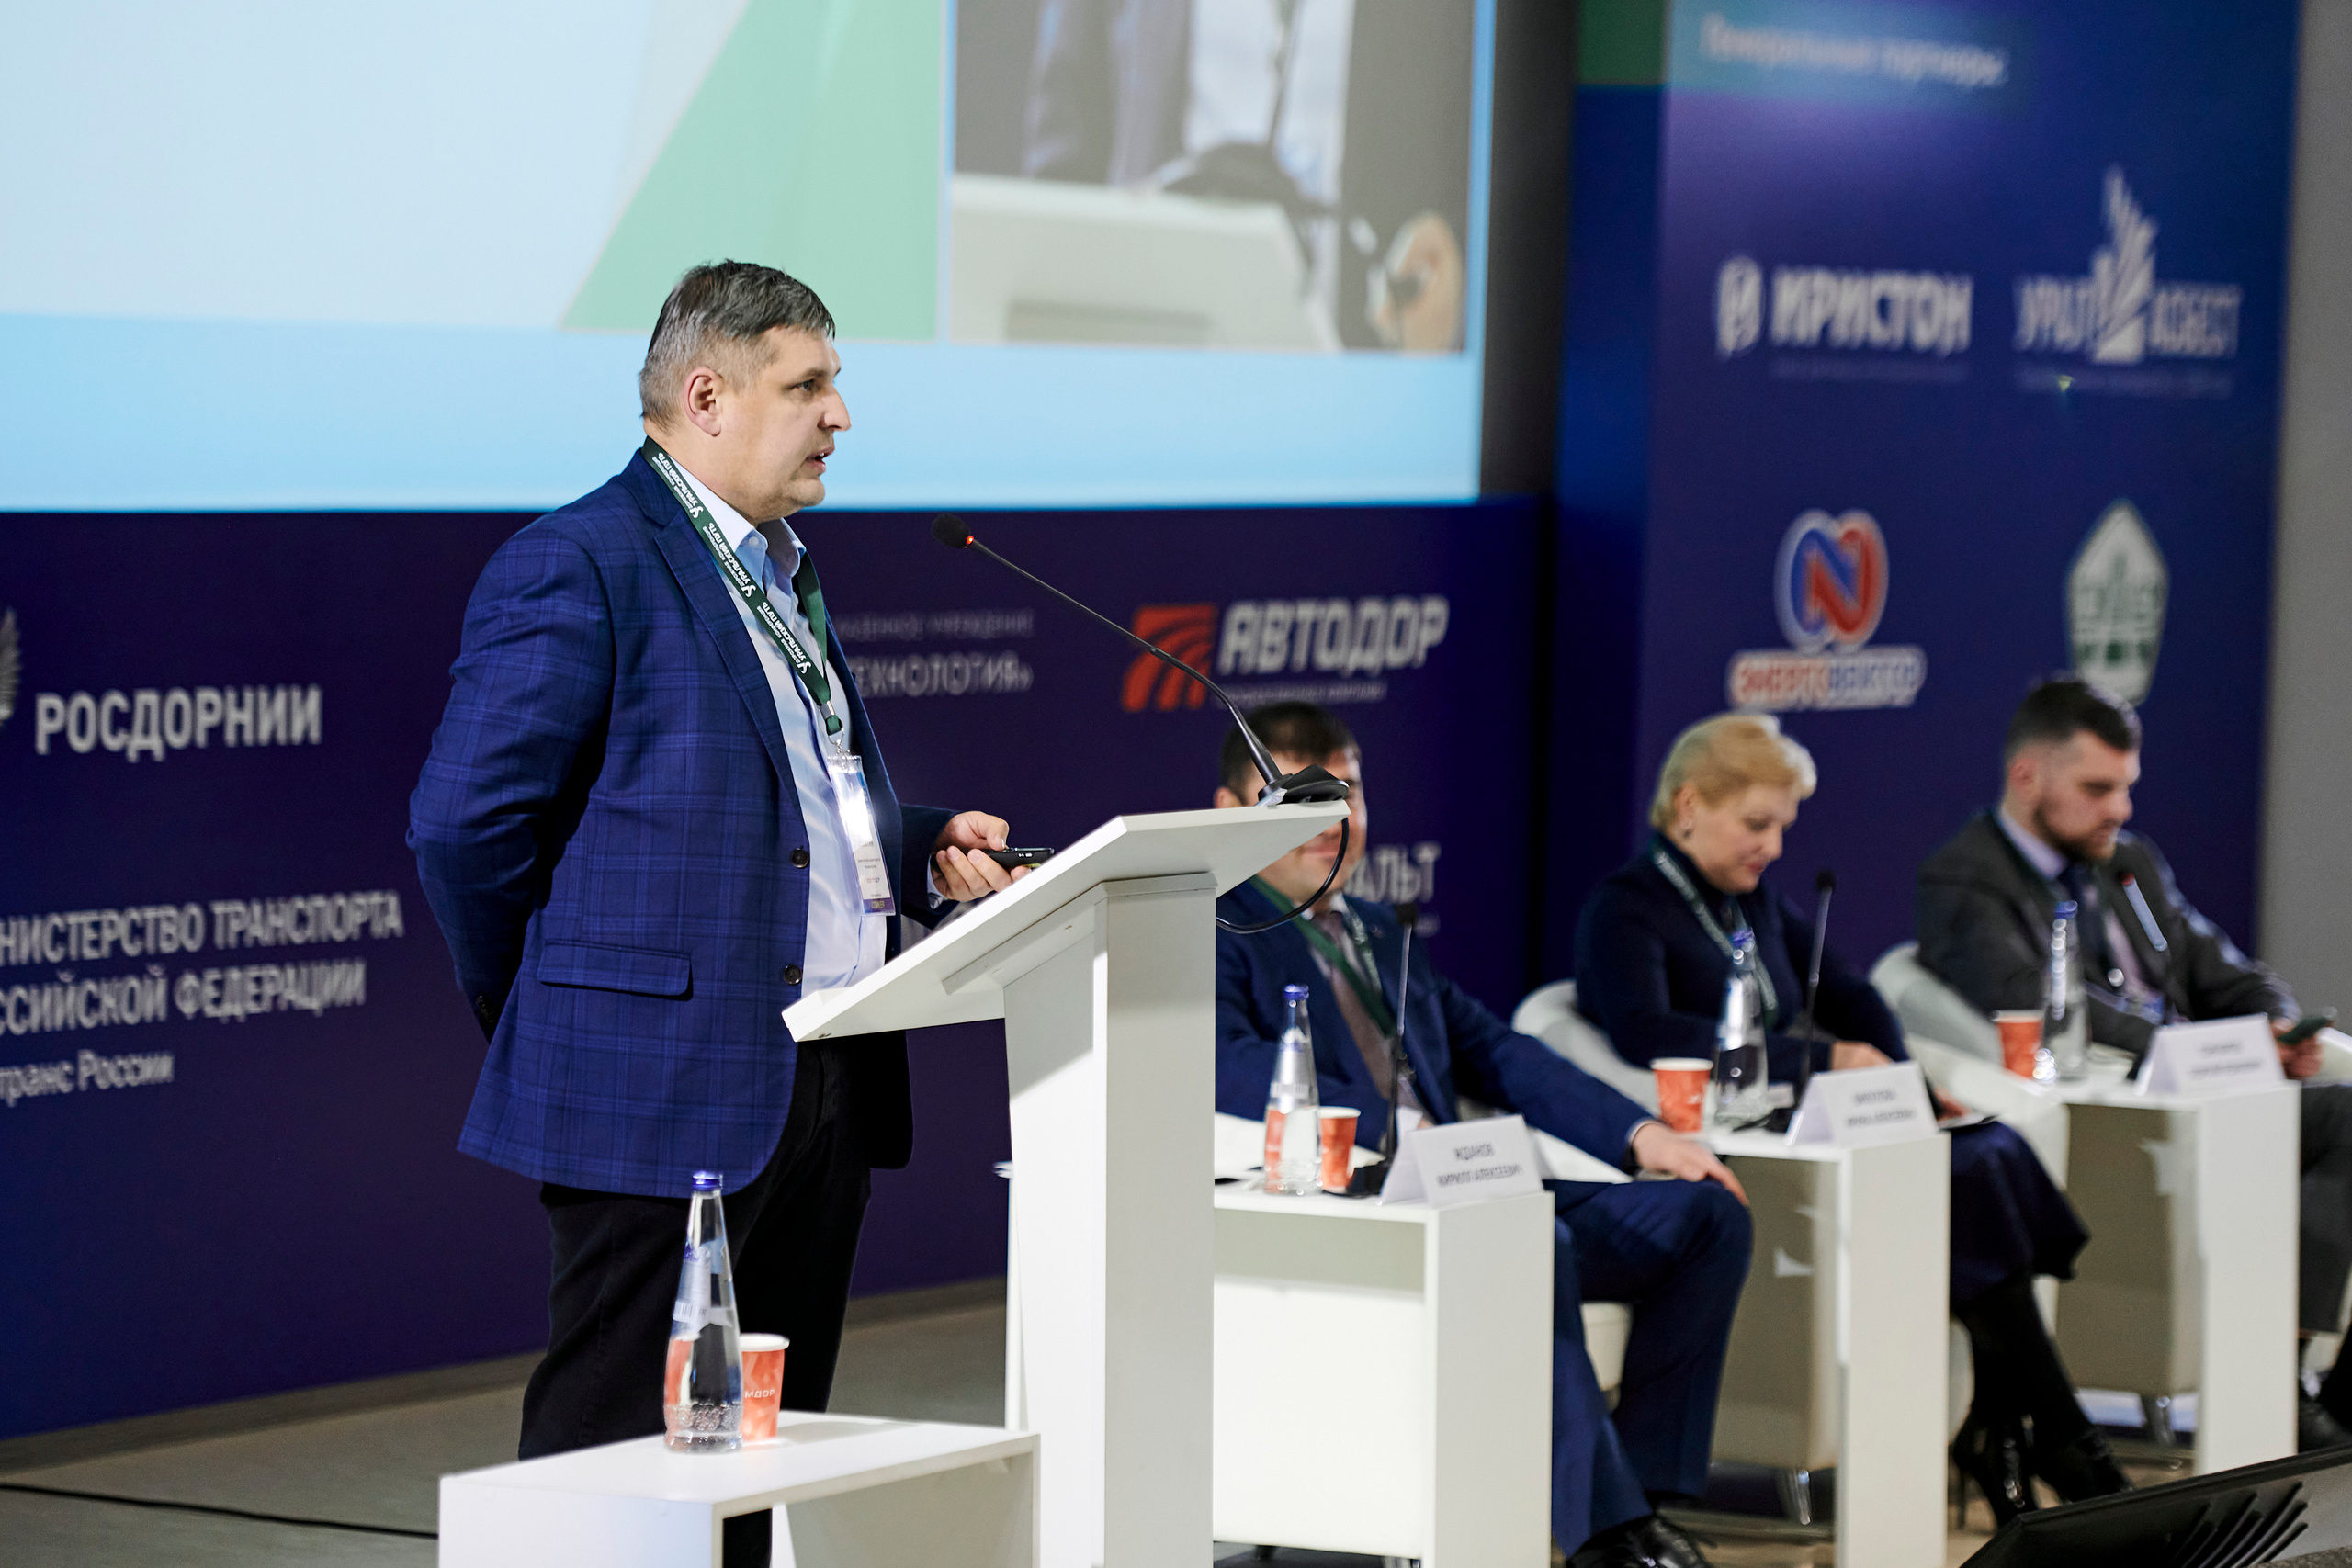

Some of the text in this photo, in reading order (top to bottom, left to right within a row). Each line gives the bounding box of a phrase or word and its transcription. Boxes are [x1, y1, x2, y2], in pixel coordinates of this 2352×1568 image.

[657, 451, 698, 506] УРАЛЬСКИЙ ПУТЬ
[707, 522, 751, 584] УРАЛЬСКИЙ ПУТЬ
[761, 601, 806, 660] УРАЛЬСКИЙ ПУТЬ
[1216, 593, 1450, 678] АВТОДОР
[35, 684, 322, 762] РОСДОРНИИ
[0, 888, 404, 965] НИСТЕРСТВО ТРАНСПОРТА
[0, 958, 367, 1036] СИЙСКОЙ ФЕДЕРАЦИИ
[77, 1048, 175, 1091] России
